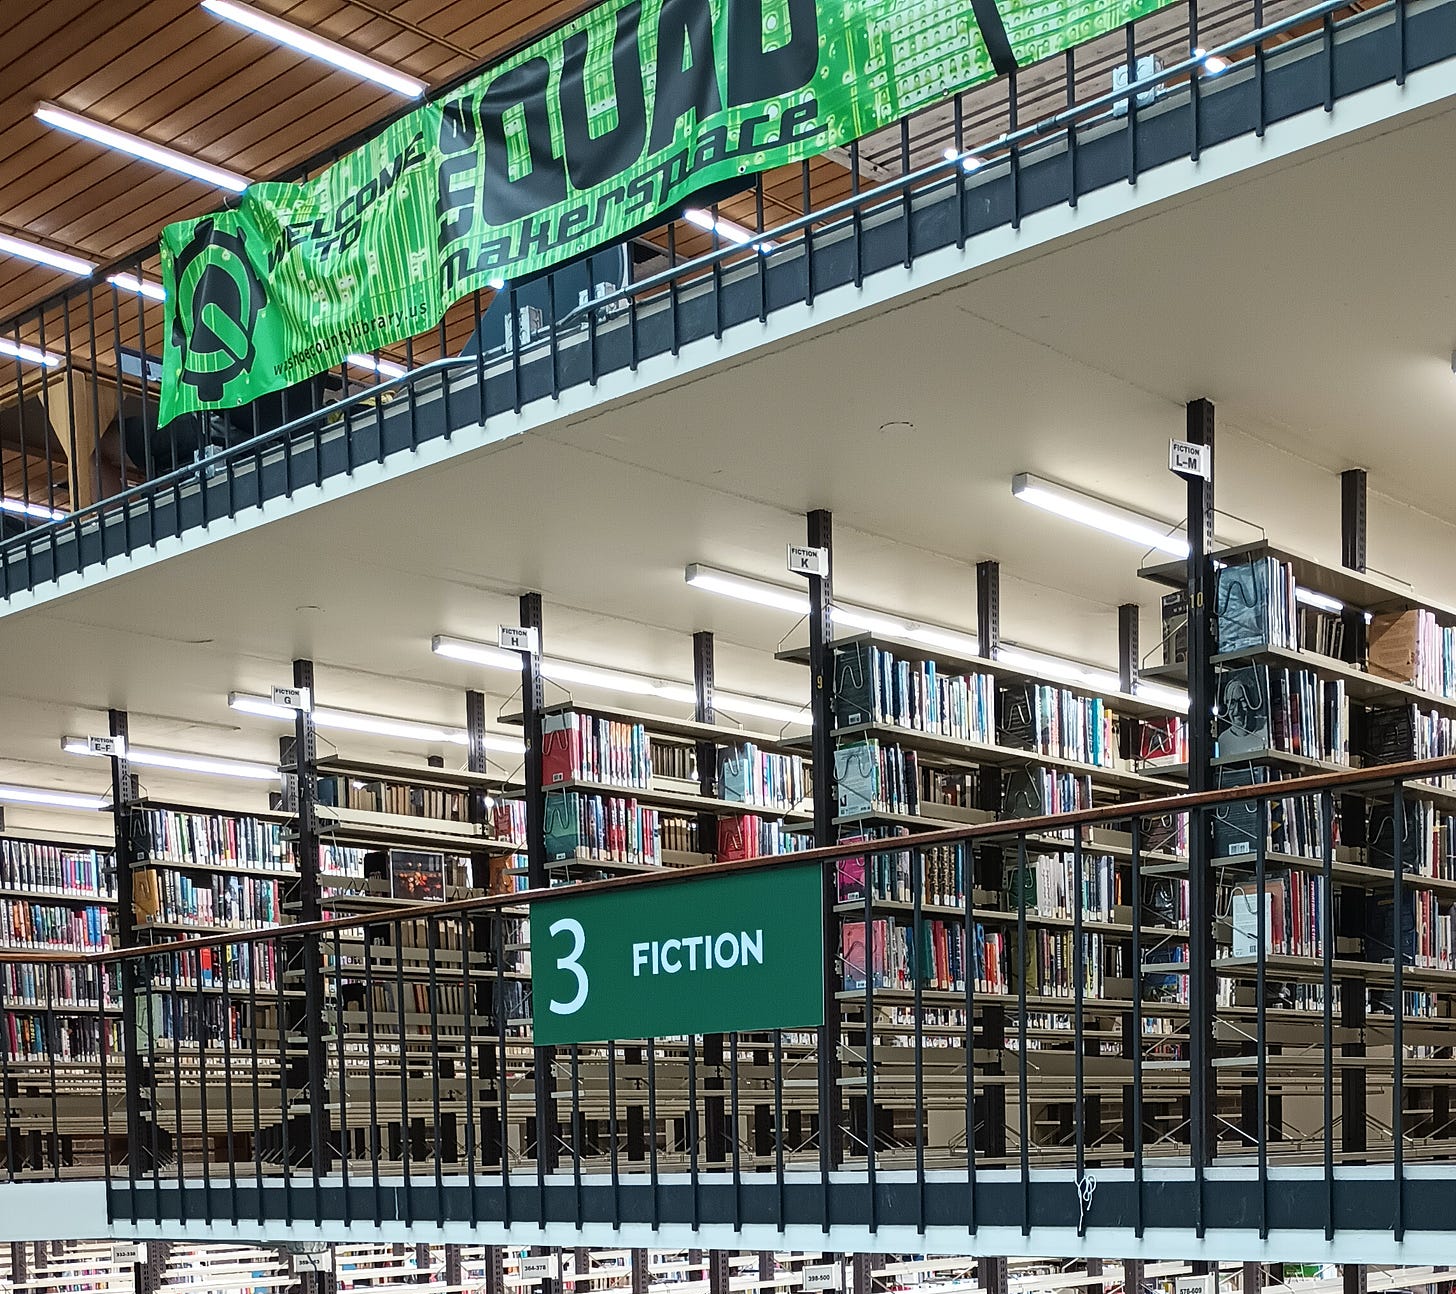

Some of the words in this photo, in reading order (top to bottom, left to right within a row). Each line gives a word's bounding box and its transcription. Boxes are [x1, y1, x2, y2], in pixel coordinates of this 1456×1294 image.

[478, 0, 819, 226] QUAD
[268, 131, 426, 273] WELCOME
[440, 98, 828, 295] makerspace
[315, 220, 361, 263] TO
[1173, 444, 1200, 456] FICTION
[1176, 454, 1197, 470] L-M
[791, 547, 817, 557] FICTION
[801, 558, 809, 568] K
[1190, 592, 1204, 608] 10
[502, 628, 527, 637] FICTION
[511, 637, 519, 646] H
[816, 675, 823, 689] 9
[275, 688, 300, 696] FICTION
[284, 696, 292, 704] G
[548, 917, 589, 1015] 3
[632, 929, 764, 977] FICTION
